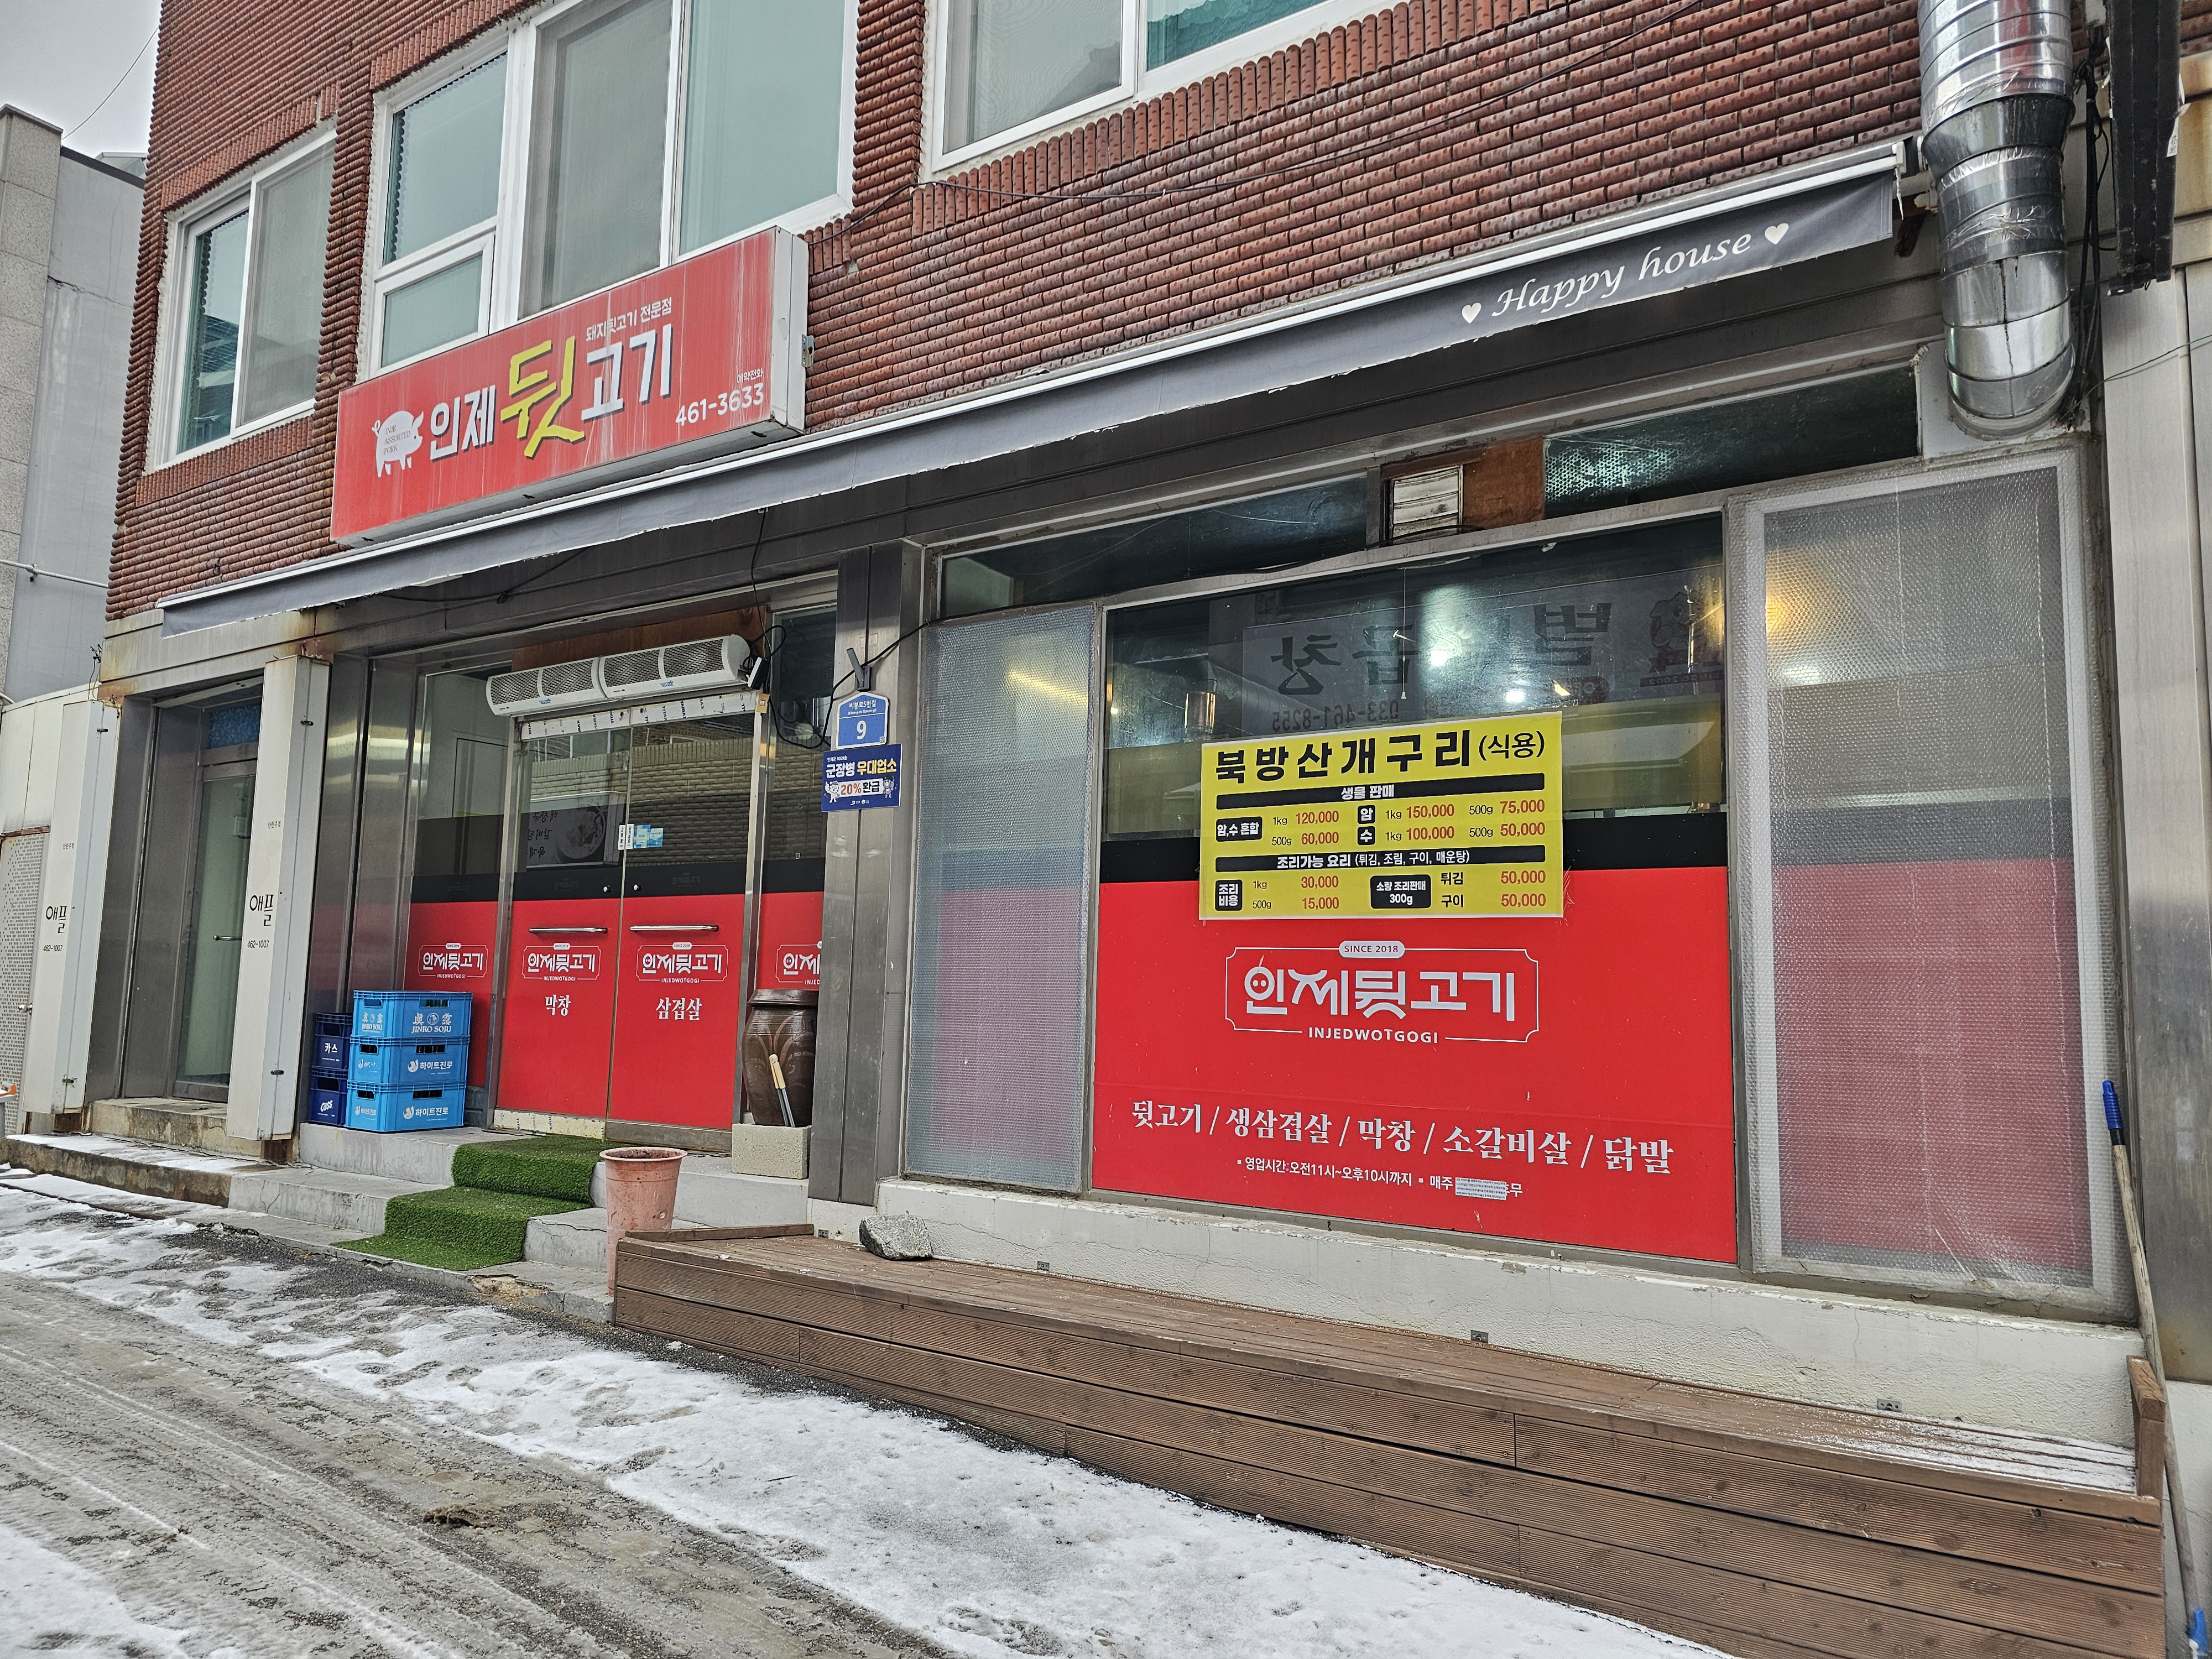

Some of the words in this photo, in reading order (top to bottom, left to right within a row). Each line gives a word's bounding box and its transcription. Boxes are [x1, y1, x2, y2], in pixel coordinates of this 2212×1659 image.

[1491, 266, 1625, 317] Happy
[1638, 233, 1752, 280] house
[639, 297, 673, 323] 전문점
[737, 367, 764, 384] 예약전화
[675, 382, 764, 426] 461-3633
[384, 430, 411, 445] ASSORTED
[385, 425, 397, 435] INJE
[384, 445, 398, 455] PORK
[857, 720, 867, 740] 9
[1215, 729, 1470, 784] 북방산개구리
[1478, 731, 1546, 761] (식용)
[826, 761, 855, 779] 군장병
[857, 758, 897, 775] 우대업소
[841, 782, 861, 795] 20%
[863, 781, 880, 794] 환급
[1341, 787, 1365, 800] 생물
[1369, 784, 1395, 799] 판매
[1272, 816, 1287, 826] 1kg
[1295, 810, 1339, 825] 120,000
[1360, 807, 1373, 822] 암
[1385, 810, 1402, 821] 1kg
[1406, 804, 1455, 820] 150,000
[1469, 804, 1493, 816] 500g
[1500, 800, 1545, 815] 75,000
[1240, 822, 1260, 836] 혼합
[1360, 829, 1373, 843] 수
[1385, 831, 1402, 842] 1kg
[1406, 826, 1455, 841] 100,000
[1469, 826, 1493, 838] 500g
[1500, 822, 1546, 837] 50,000
[1272, 836, 1292, 847] 500g
[1301, 832, 1339, 846] 60,000
[1277, 854, 1324, 869] 조리가능
[1327, 854, 1352, 867] 요리
[1355, 853, 1380, 867] (튀김,
[1383, 853, 1406, 866] 조림,
[1408, 852, 1432, 865] 구이,
[1436, 850, 1470, 864] 매운탕)
[1253, 880, 1267, 890] 1kg
[1301, 875, 1339, 889] 30,000
[1441, 871, 1464, 885] 튀김
[1500, 870, 1546, 885] 50,000
[1218, 885, 1239, 895] 조리
[1376, 882, 1392, 891] 소량
[1394, 881, 1426, 891] 조리판매
[1218, 895, 1239, 907] 비용
[1252, 899, 1272, 910] 500g
[1302, 897, 1339, 910] 15,000
[1390, 894, 1413, 906] 300g
[1441, 894, 1464, 908] 구이
[1500, 893, 1546, 907] 50,000
[43, 944, 62, 952] 462-1007
[247, 940, 269, 949] 462-1007
[1344, 945, 1372, 954] SINCE
[1375, 945, 1399, 954] 2018
[423, 952, 483, 971] 인제뒷고기
[528, 953, 596, 972] 인제뒷고기
[643, 953, 722, 974] 인제뒷고기
[1244, 962, 1515, 1021] 인제뒷고기
[545, 994, 571, 1016] 막창
[655, 997, 702, 1021] 삼겹살
[411, 1025, 432, 1034] JINRO
[1308, 1027, 1438, 1044] INJEDWOTGOGI
[325, 1042, 338, 1053] 카스
[419, 1061, 452, 1070] 하이트진로
[415, 1107, 448, 1117] 하이트진로
[1131, 1100, 1202, 1133] 뒷고기
[1225, 1107, 1332, 1144] 생삼겹살
[1358, 1117, 1416, 1152] 막창
[1443, 1125, 1572, 1166] 소갈비살
[1604, 1136, 1674, 1174] 닭발
[1430, 1175, 1453, 1191] 매주
